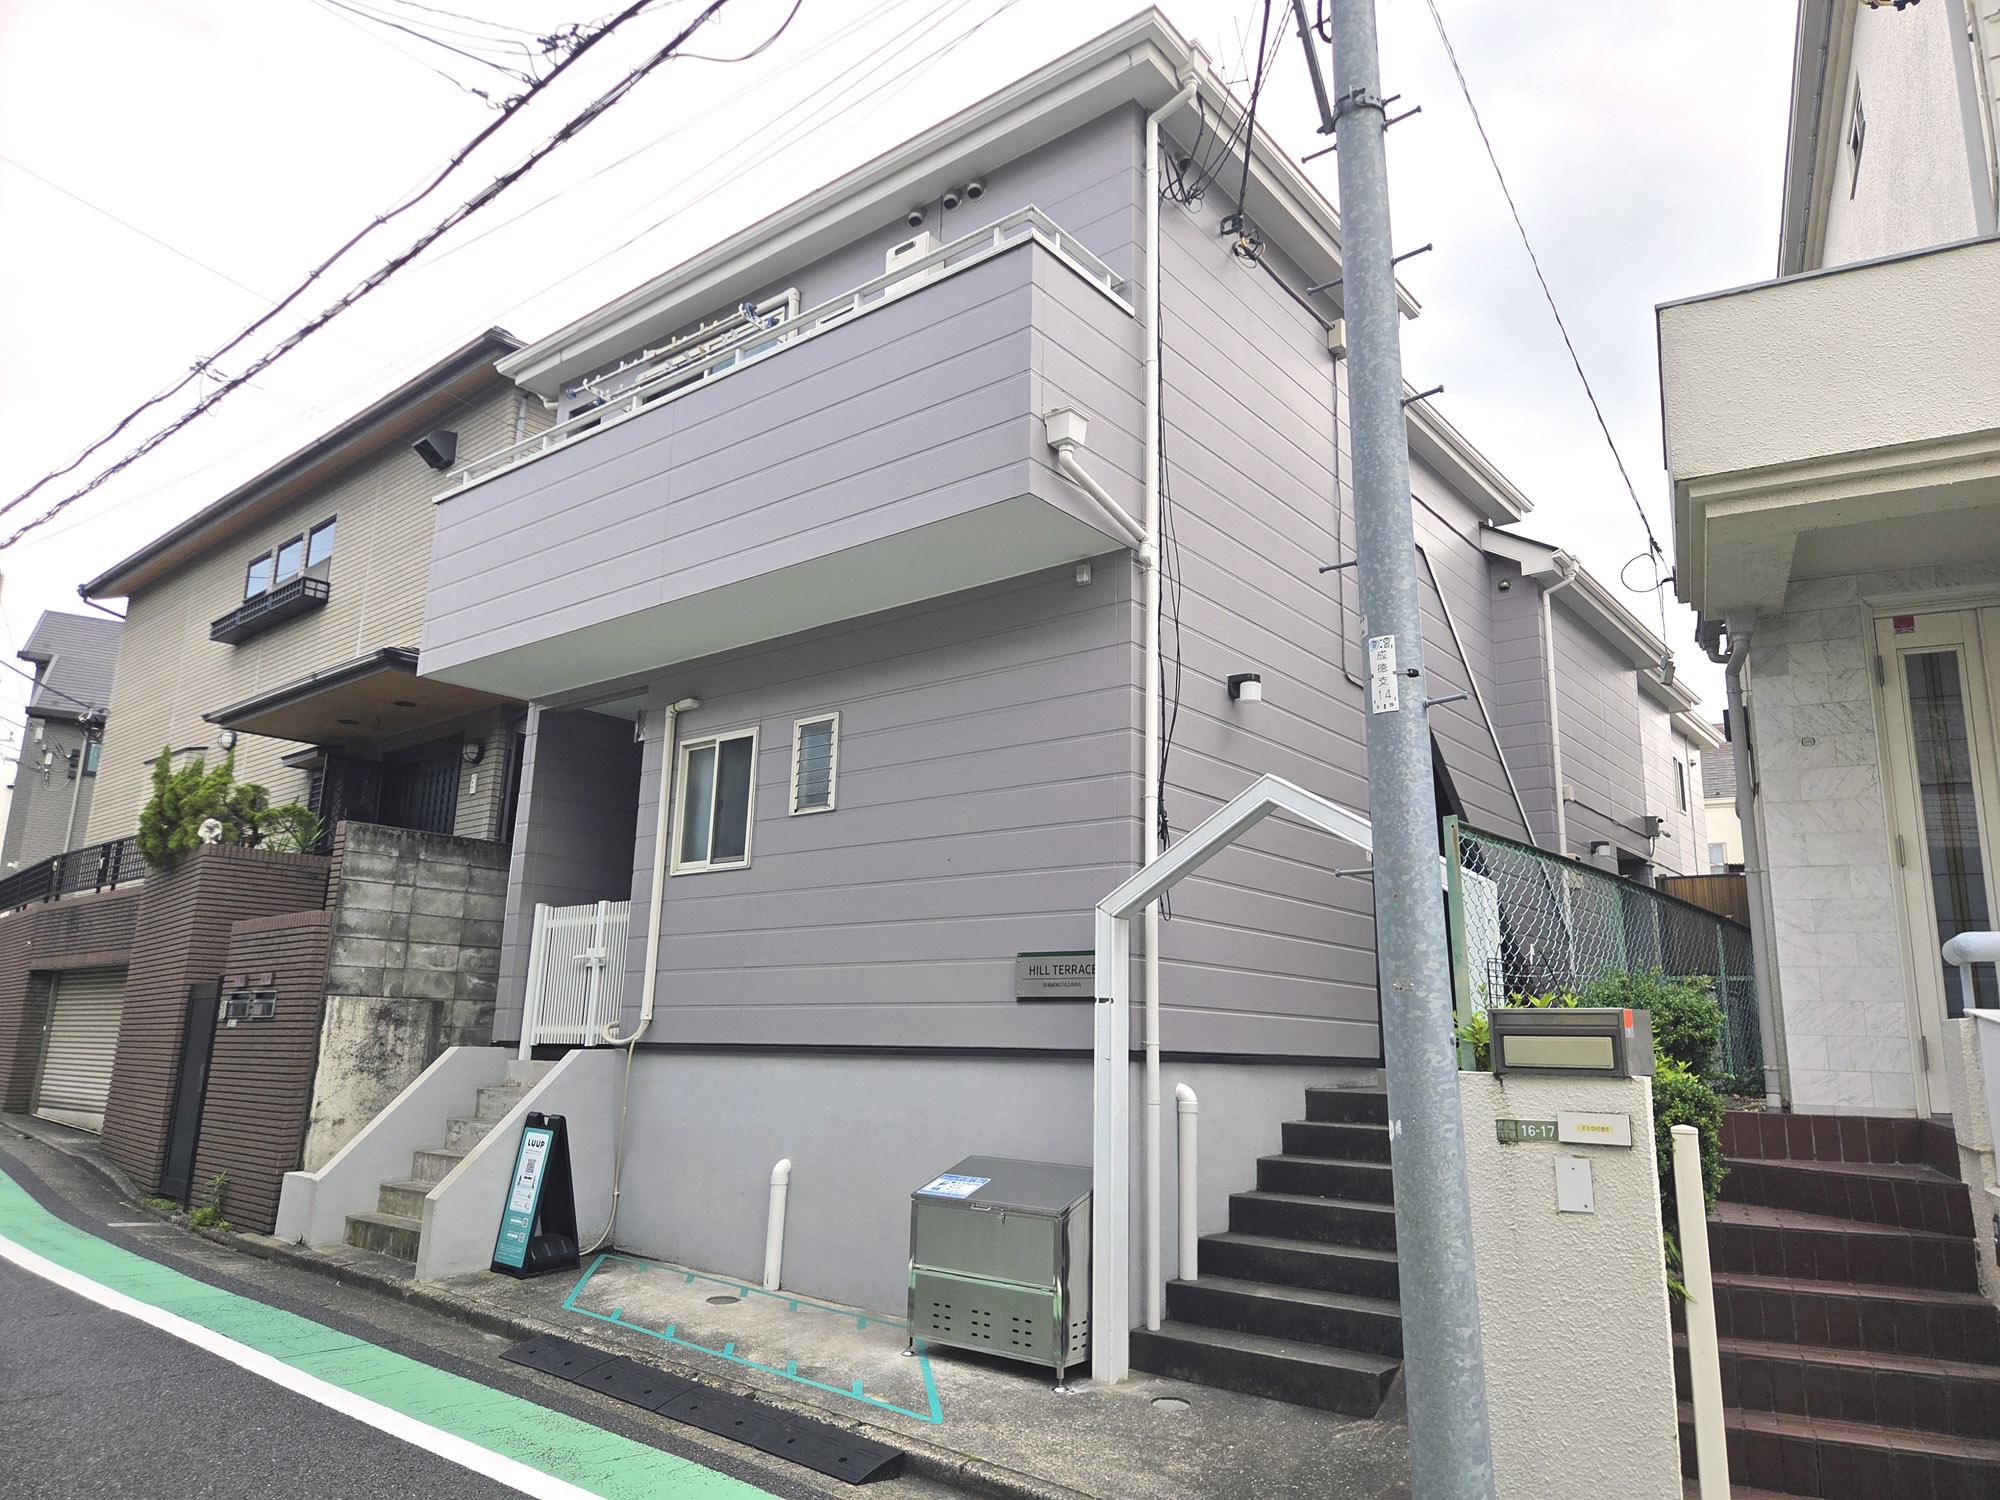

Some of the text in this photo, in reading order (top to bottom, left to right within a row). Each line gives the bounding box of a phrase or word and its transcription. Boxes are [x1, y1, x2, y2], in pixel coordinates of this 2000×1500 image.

[1378, 689, 1392, 700] 14
[1028, 963, 1095, 976] HILL TERRACE
[1521, 1124, 1555, 1138] 16-17
[527, 1138, 546, 1148] LUUP
